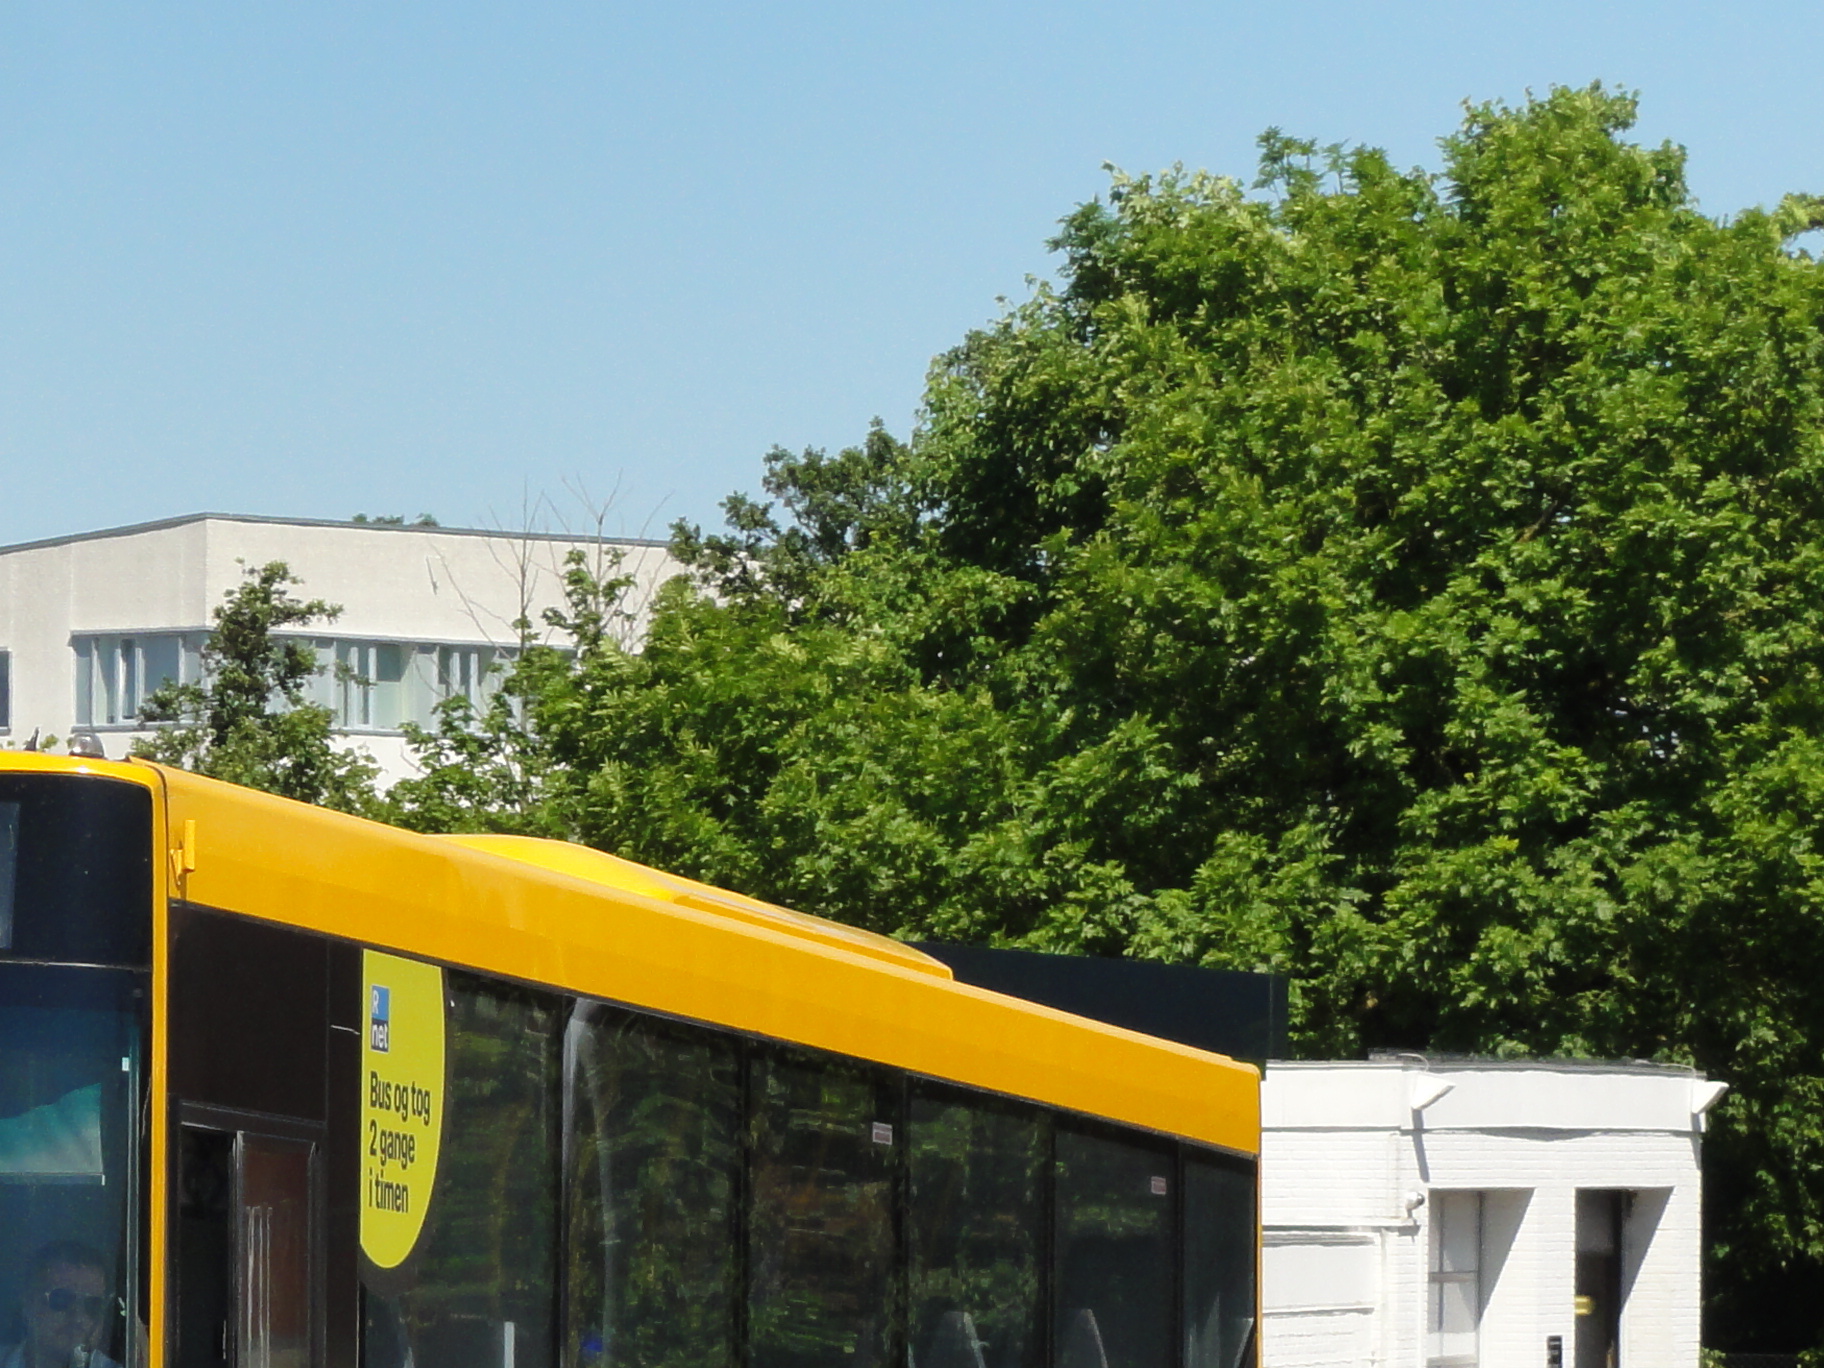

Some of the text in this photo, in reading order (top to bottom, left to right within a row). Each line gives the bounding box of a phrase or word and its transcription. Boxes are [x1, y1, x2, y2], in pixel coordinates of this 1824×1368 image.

[372, 1023, 388, 1049] net
[370, 1071, 430, 1127] Bus og tog
[369, 1119, 415, 1169] 2 gange
[375, 1169, 408, 1214] timen
